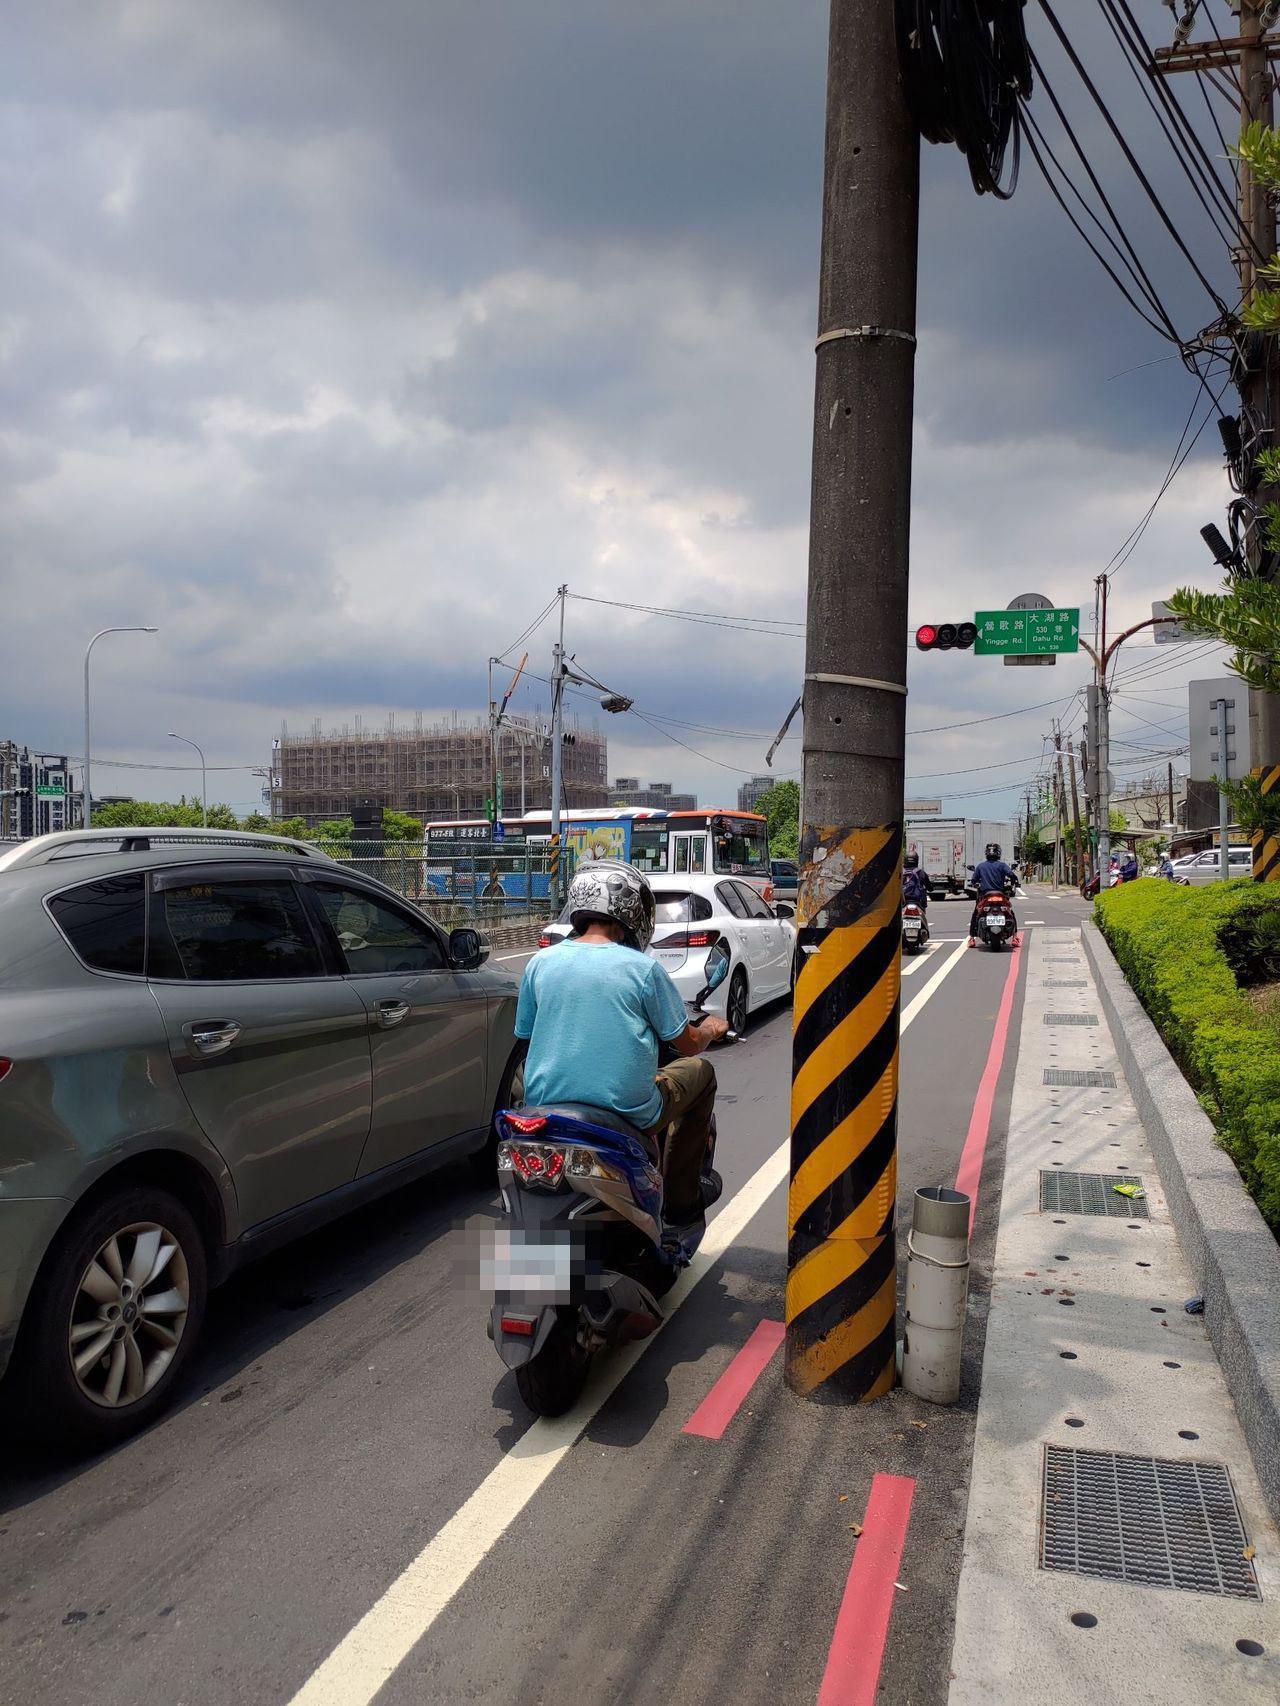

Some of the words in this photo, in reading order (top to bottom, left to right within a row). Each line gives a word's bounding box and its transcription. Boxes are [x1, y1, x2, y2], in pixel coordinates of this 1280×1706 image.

[1029, 613, 1069, 623] 大湖路
[985, 621, 1024, 631] 鶯歌路
[985, 638, 1009, 646] Yingge
